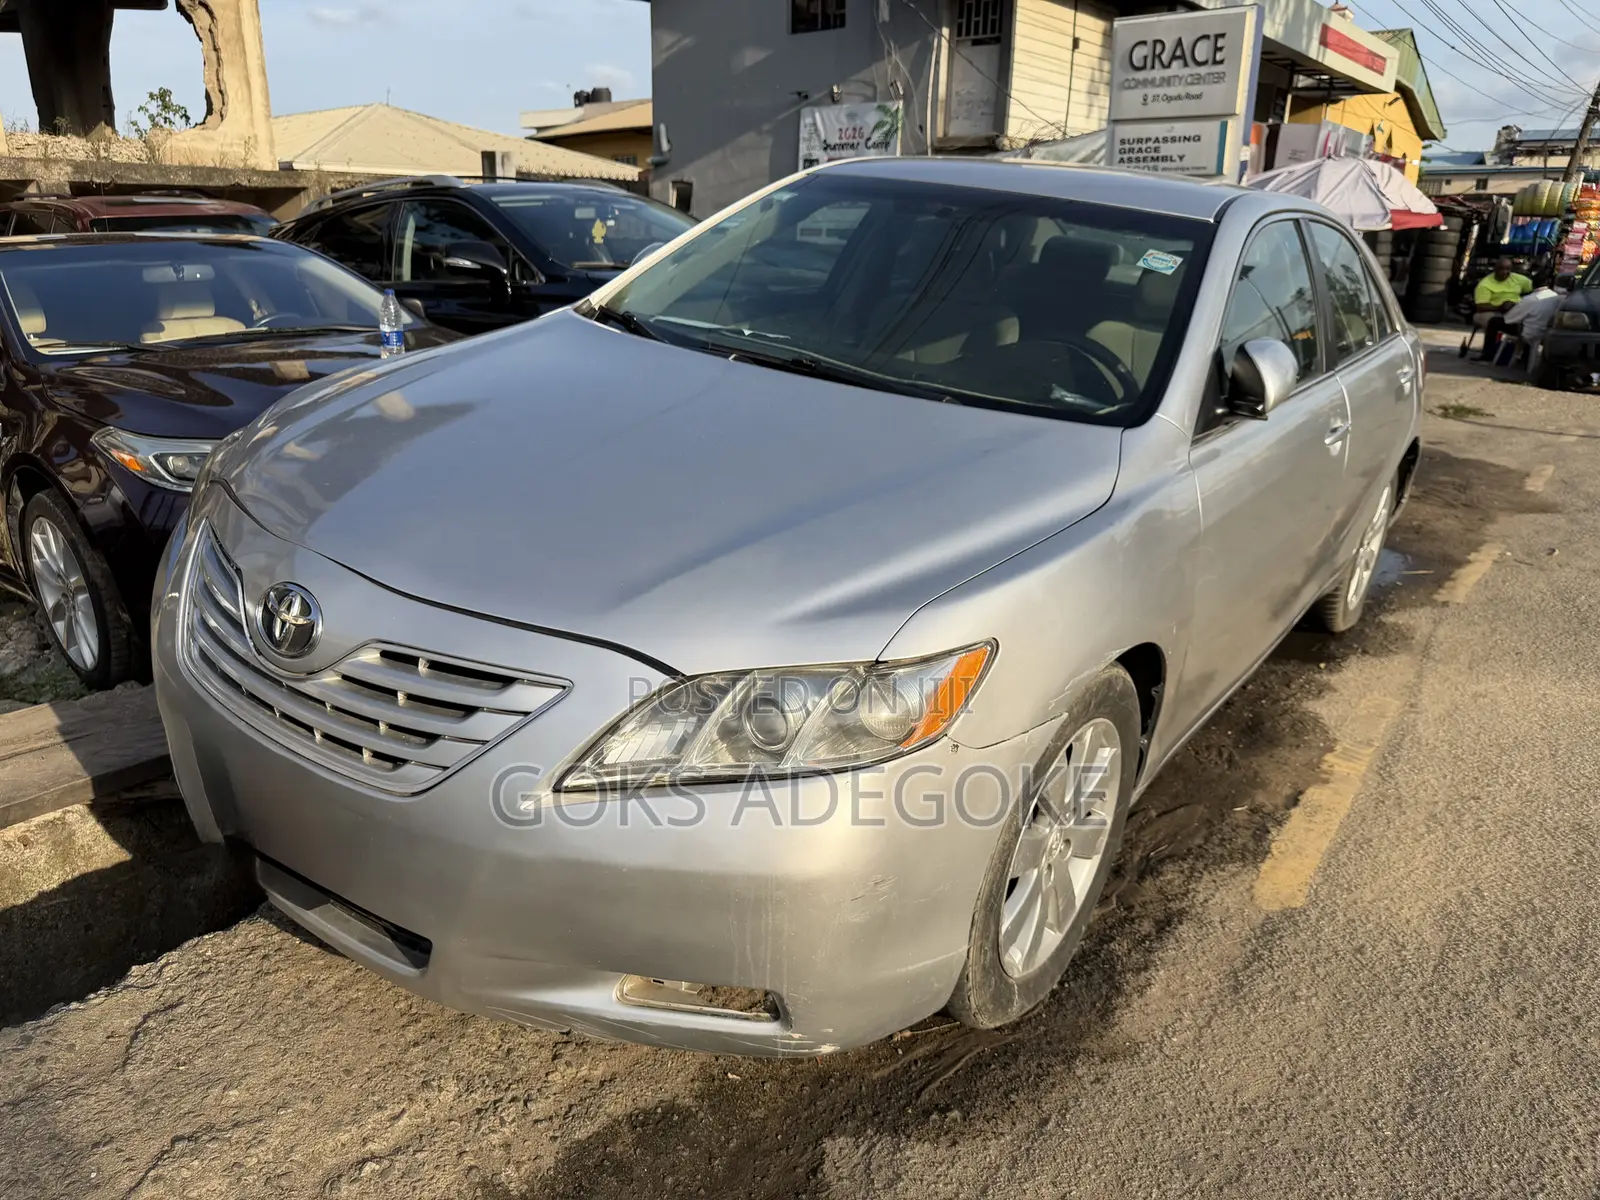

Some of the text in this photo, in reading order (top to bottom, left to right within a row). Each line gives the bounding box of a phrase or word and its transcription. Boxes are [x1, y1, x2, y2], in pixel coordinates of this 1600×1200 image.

[1129, 33, 1227, 71] GRACE
[1122, 72, 1227, 90] COMMUNITY CENTER
[1185, 92, 1203, 101] Road
[822, 139, 860, 152] Summer
[865, 137, 891, 152] Camp
[1119, 135, 1202, 146] SURPASSING
[1118, 146, 1161, 155] GRACE
[1118, 154, 1186, 164] ASSEMBLY
